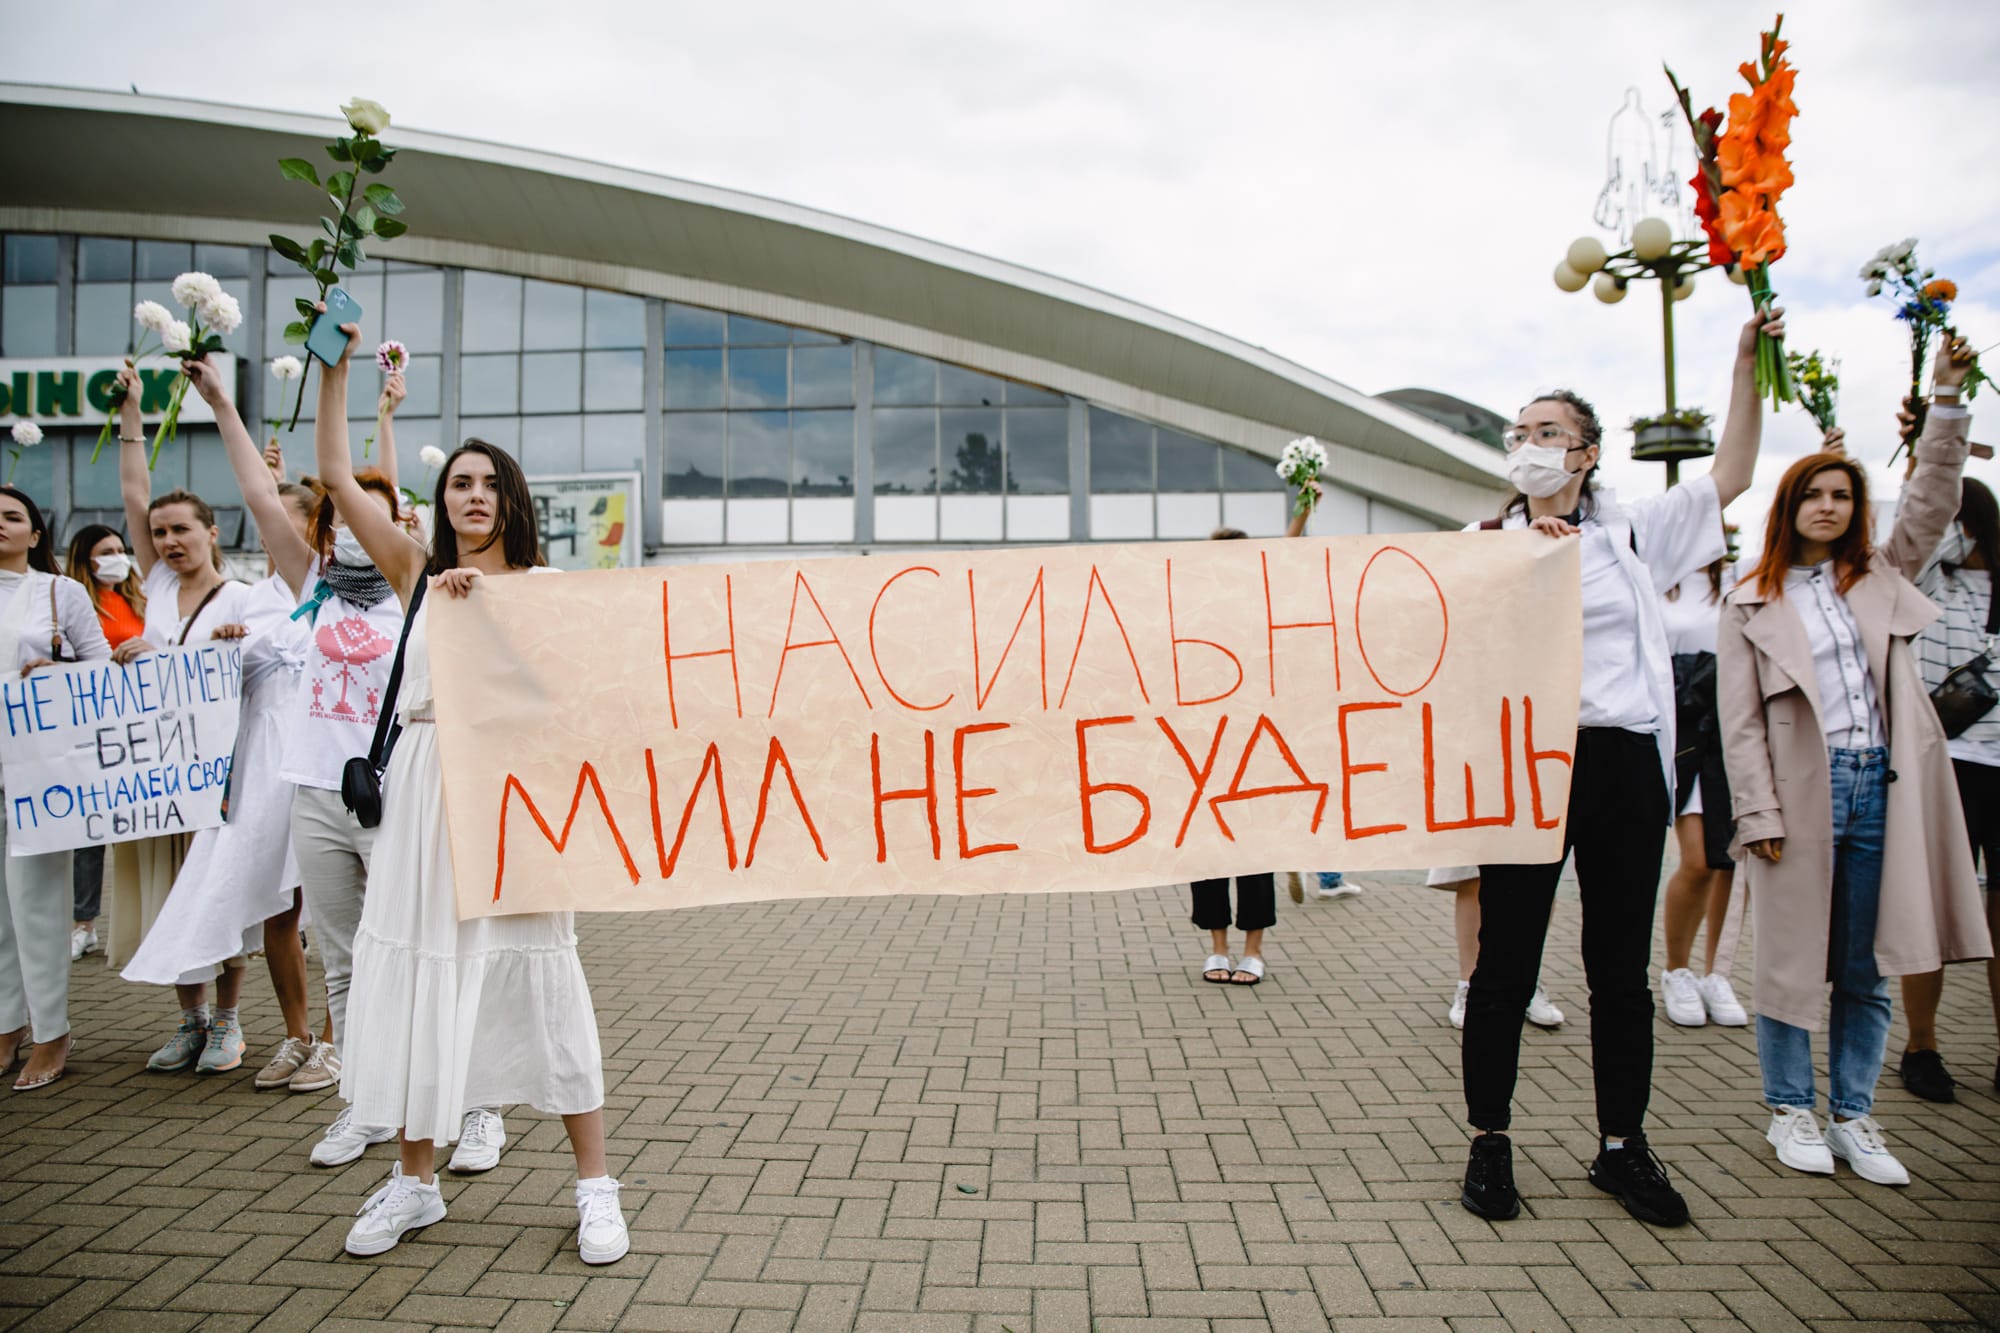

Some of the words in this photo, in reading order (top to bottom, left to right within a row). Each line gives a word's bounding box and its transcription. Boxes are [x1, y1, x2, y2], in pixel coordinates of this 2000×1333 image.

[4, 674, 58, 737] НЕ
[65, 653, 182, 726] ЖАЛЕЙ
[183, 646, 241, 704] МЕНЯ
[15, 763, 182, 830] ПОЖАЛЕЙ
[86, 799, 185, 841] СЫНА
[492, 736, 830, 904] МИЛ
[870, 722, 1020, 864] НЕ
[1075, 696, 1572, 854] БУДЕШЬ
